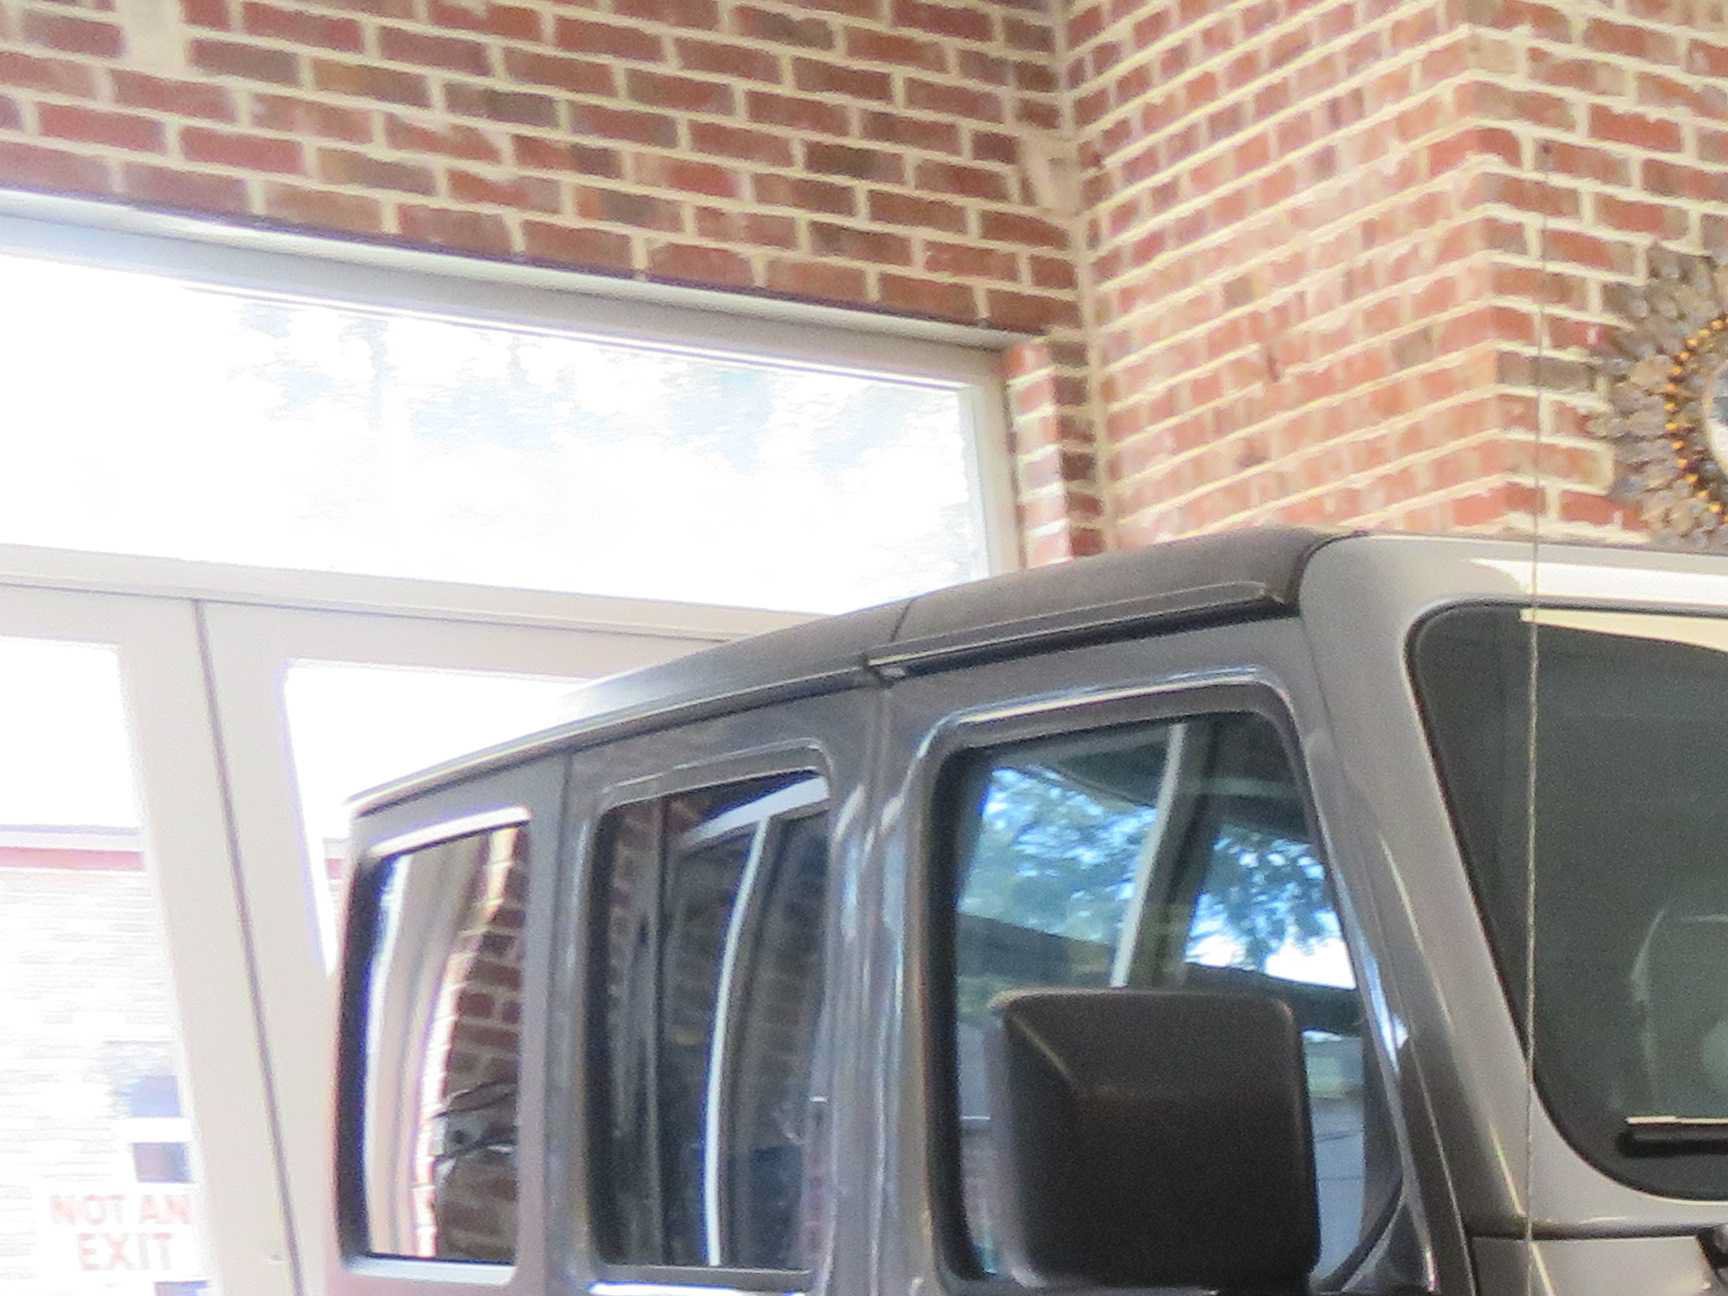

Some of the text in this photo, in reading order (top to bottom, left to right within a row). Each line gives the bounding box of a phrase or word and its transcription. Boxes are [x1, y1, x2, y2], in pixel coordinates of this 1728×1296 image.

[49, 1193, 191, 1225] NOT AN
[77, 1231, 172, 1270] EXIT
